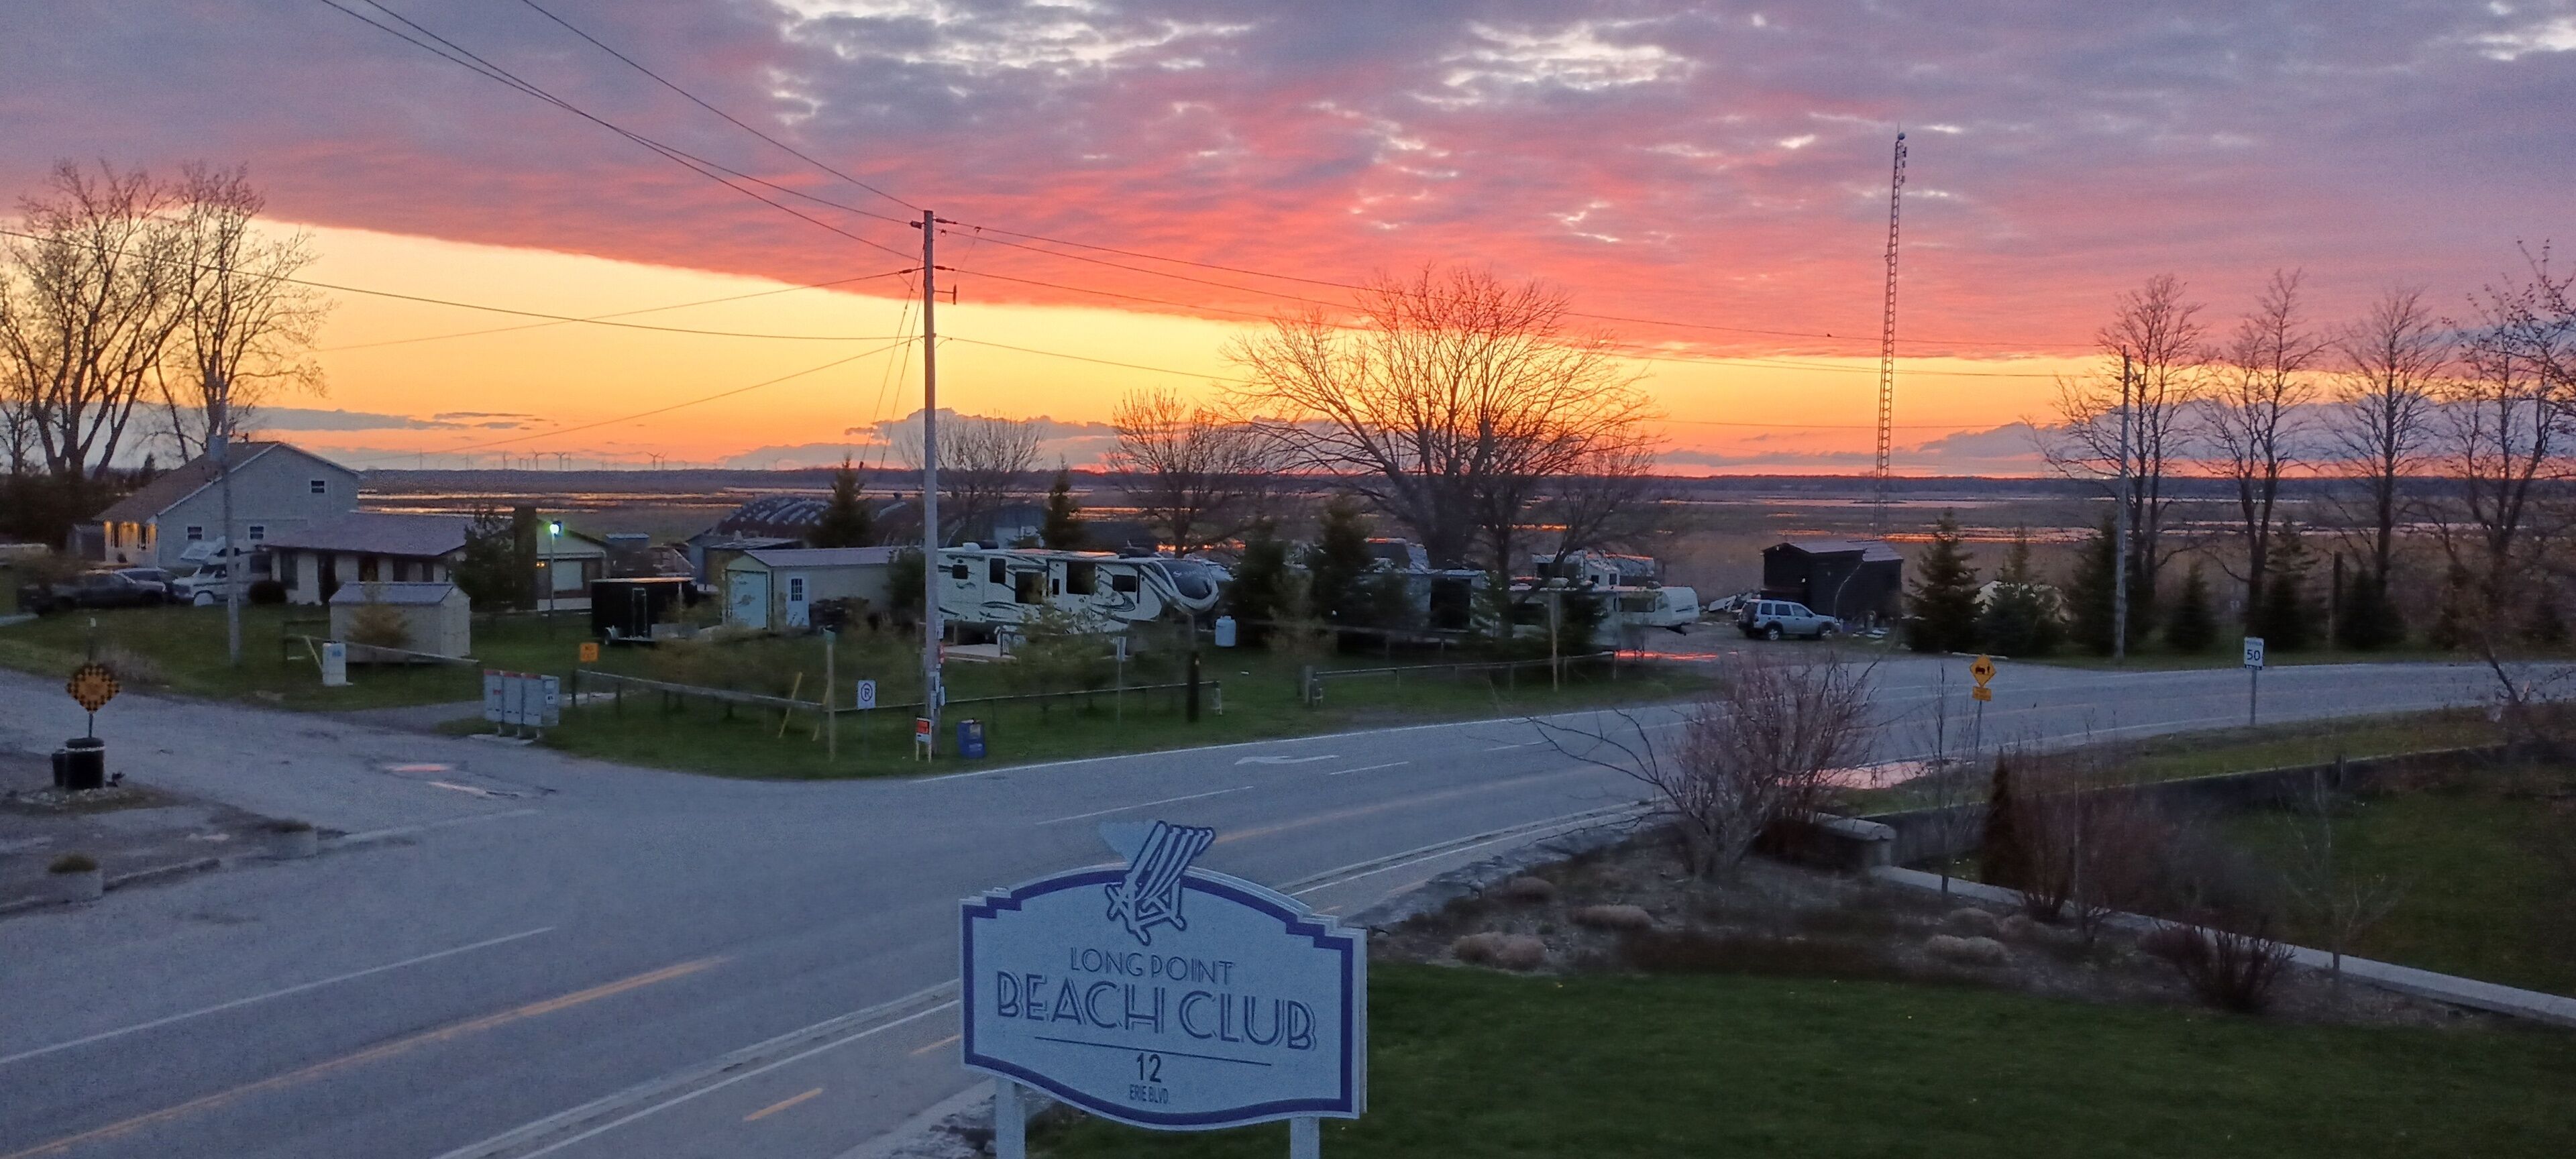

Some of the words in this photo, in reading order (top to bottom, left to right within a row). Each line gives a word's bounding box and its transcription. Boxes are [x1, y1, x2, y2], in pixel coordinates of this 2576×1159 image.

[2247, 649, 2261, 661] 50
[1071, 947, 1142, 977] LONG
[1151, 954, 1235, 985] POINT
[998, 971, 1165, 1034] BEACH
[1179, 990, 1317, 1051] CLUB
[1136, 1052, 1161, 1083] 12
[1130, 1084, 1146, 1101] ERIE
